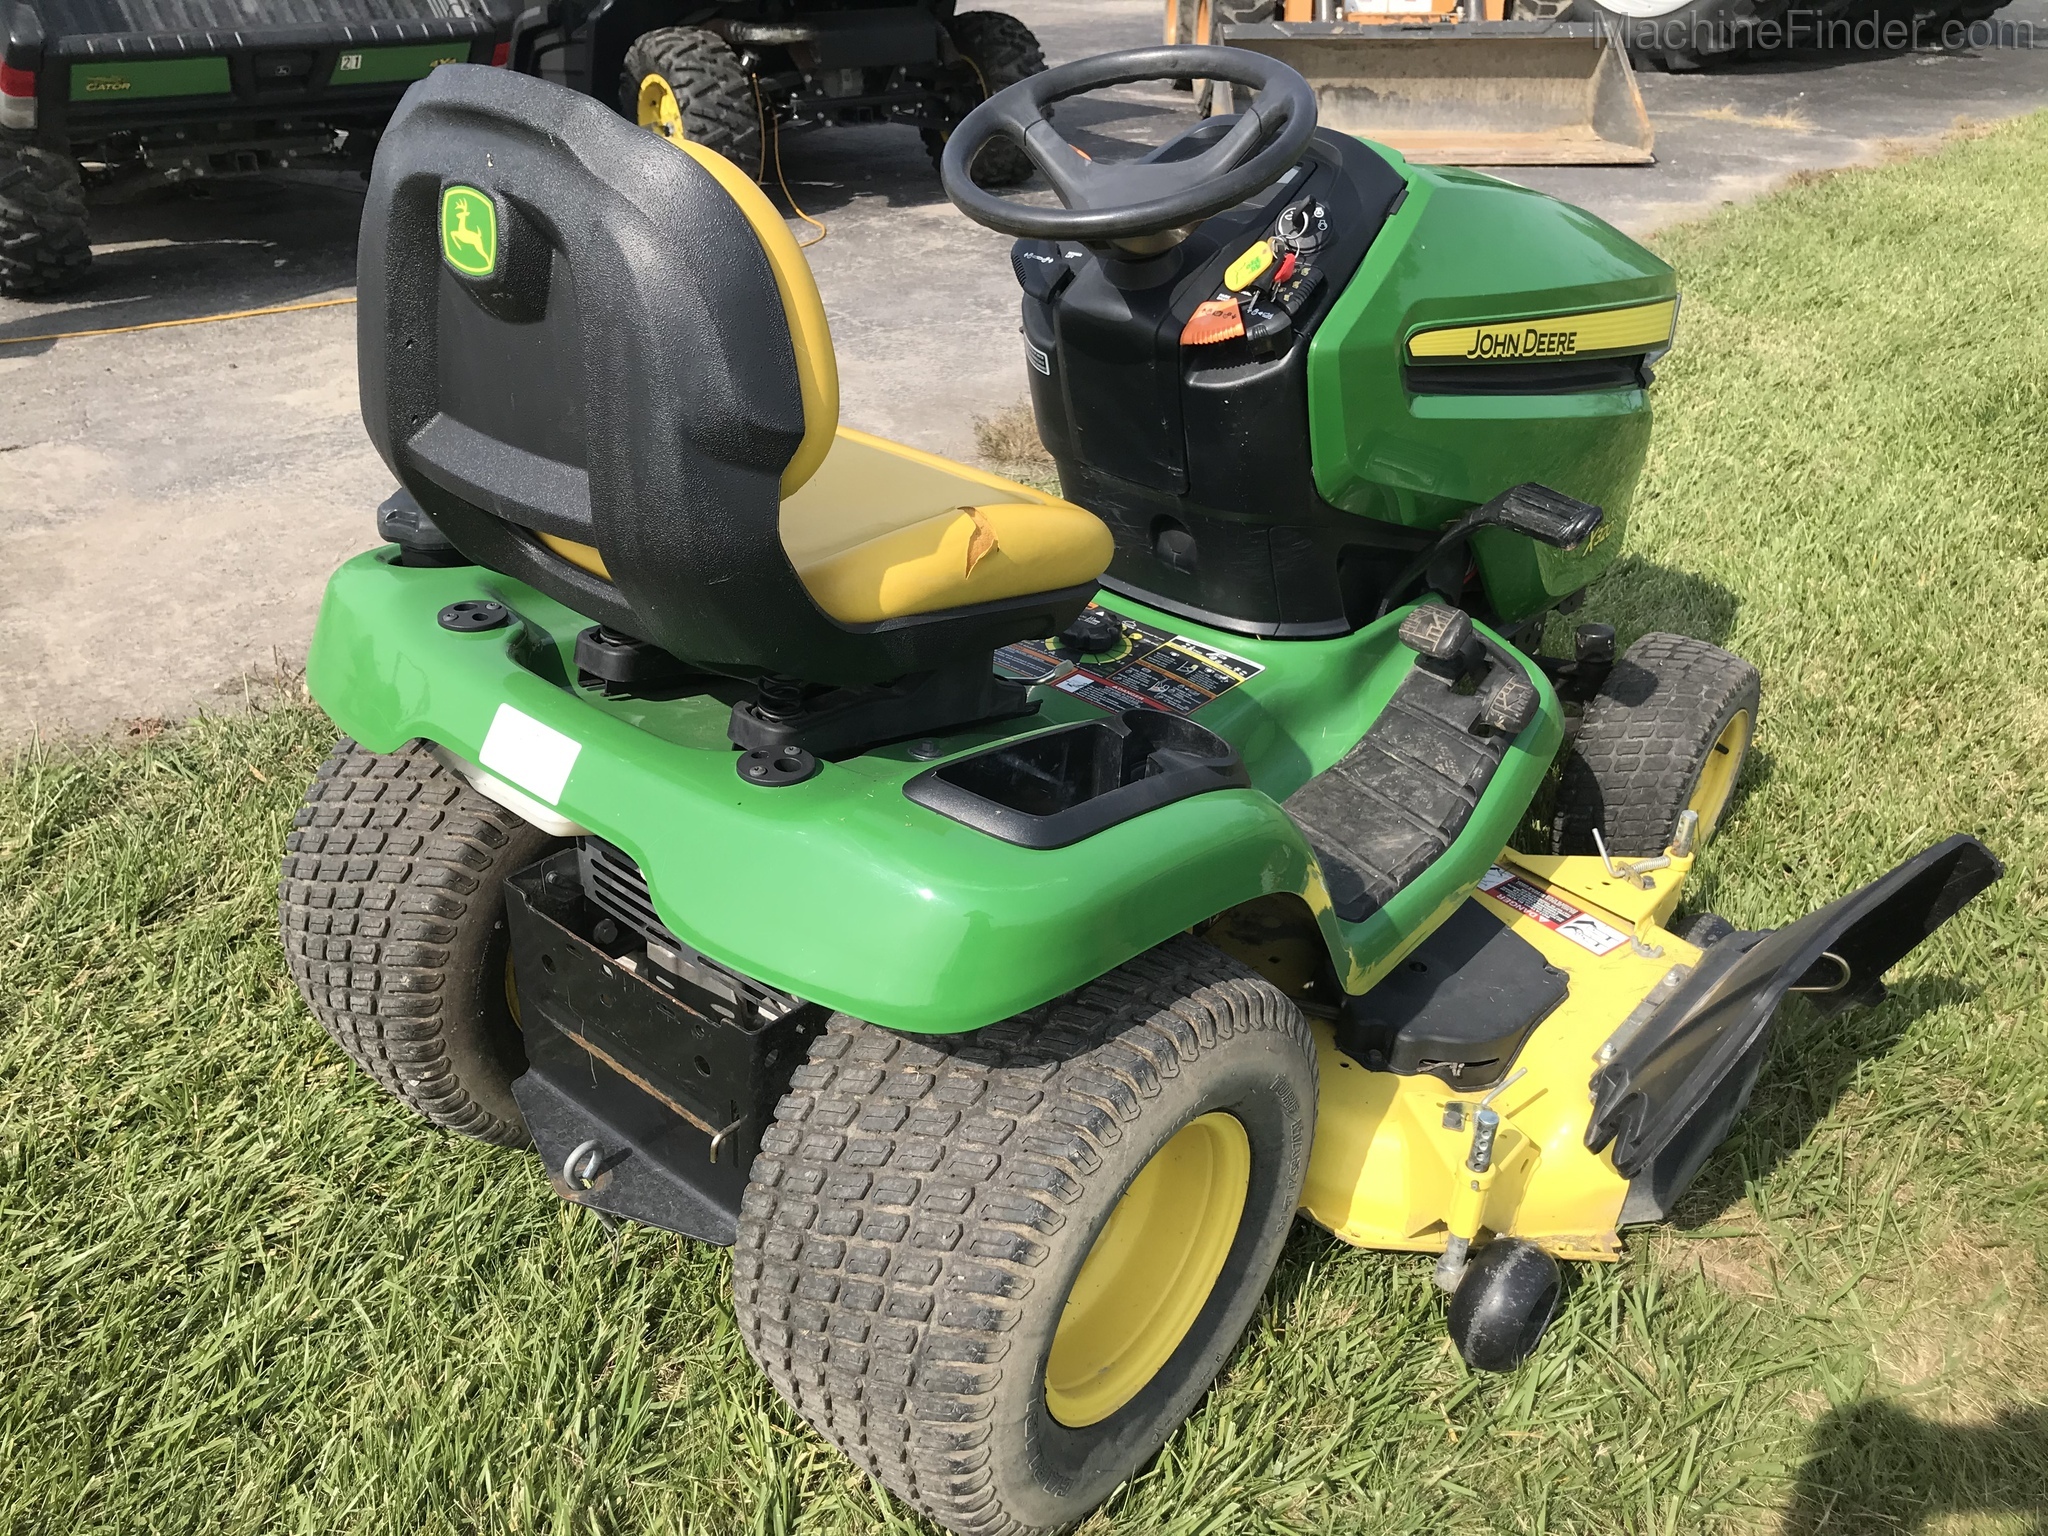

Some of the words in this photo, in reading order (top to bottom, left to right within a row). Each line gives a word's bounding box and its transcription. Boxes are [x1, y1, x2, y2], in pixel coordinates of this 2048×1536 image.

[342, 57, 360, 69] 21
[86, 82, 131, 92] GATOR
[1467, 329, 1520, 356] JOHN
[1523, 328, 1577, 354] DEERE
[1497, 893, 1538, 918] DANGER
